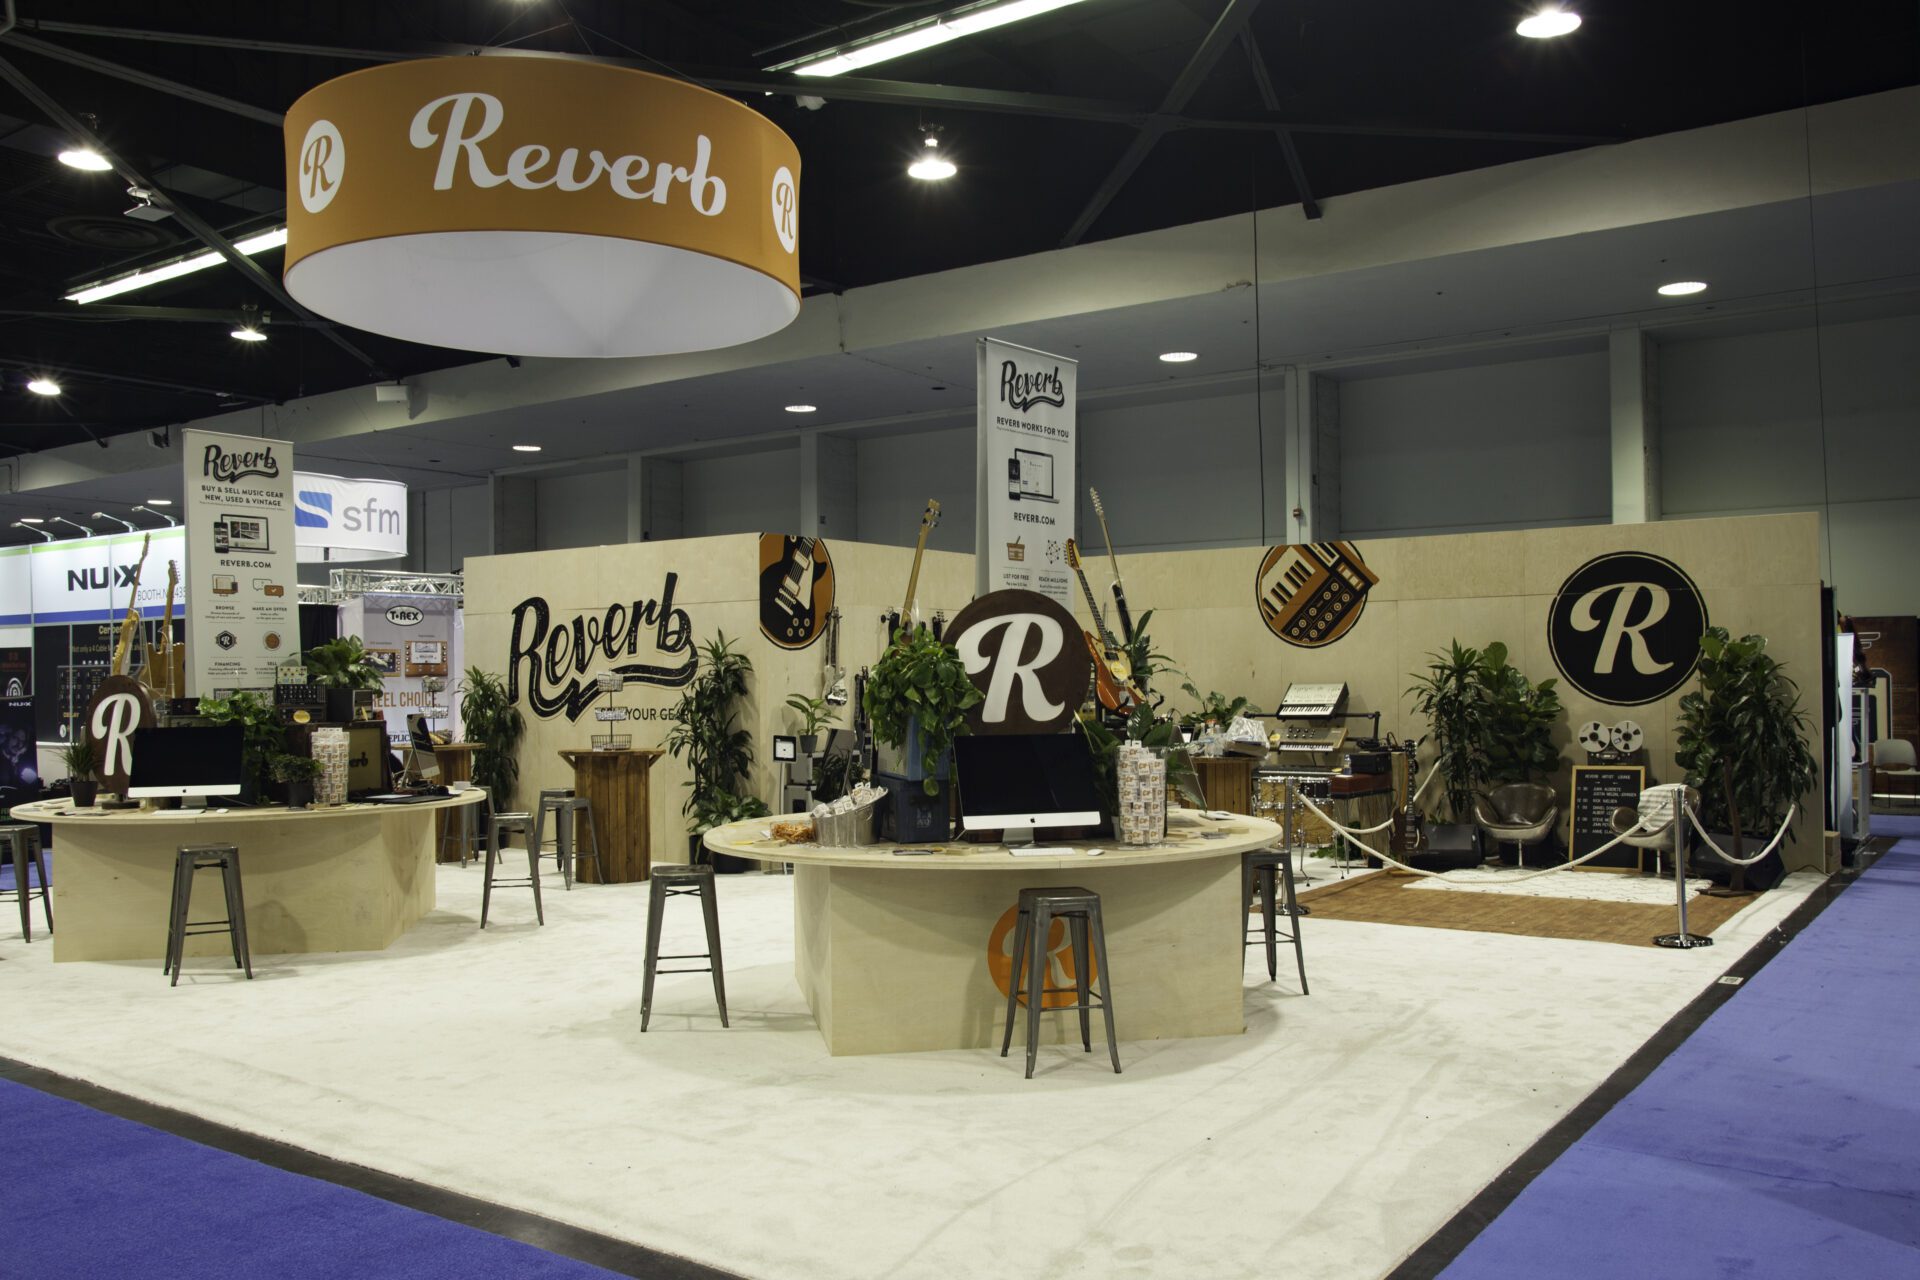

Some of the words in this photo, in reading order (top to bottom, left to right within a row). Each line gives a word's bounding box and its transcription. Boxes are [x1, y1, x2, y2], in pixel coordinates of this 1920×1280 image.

[303, 135, 335, 199] R
[409, 92, 727, 216] Reverb
[776, 182, 794, 240] R
[1001, 360, 1065, 412] Reverb
[996, 416, 1020, 428] REVERB
[1021, 421, 1043, 433] WORKS
[1044, 426, 1056, 435] FOR
[1057, 429, 1069, 438] YOU
[203, 444, 279, 482] Reverb
[205, 494, 224, 502] NEW,
[225, 496, 244, 504] USED
[252, 498, 281, 507] VINTAGE
[224, 487, 240, 495] SELL
[265, 491, 284, 499] GEAR
[342, 497, 400, 535] sfm
[1013, 512, 1056, 526] REVERB.COM
[220, 559, 272, 568] REVERB.COM
[508, 571, 699, 722] Reverb
[1570, 581, 1675, 676] R
[955, 612, 1066, 722] R
[91, 692, 141, 776] R
[626, 708, 657, 721] YOUR
[659, 708, 690, 721] GEAR
